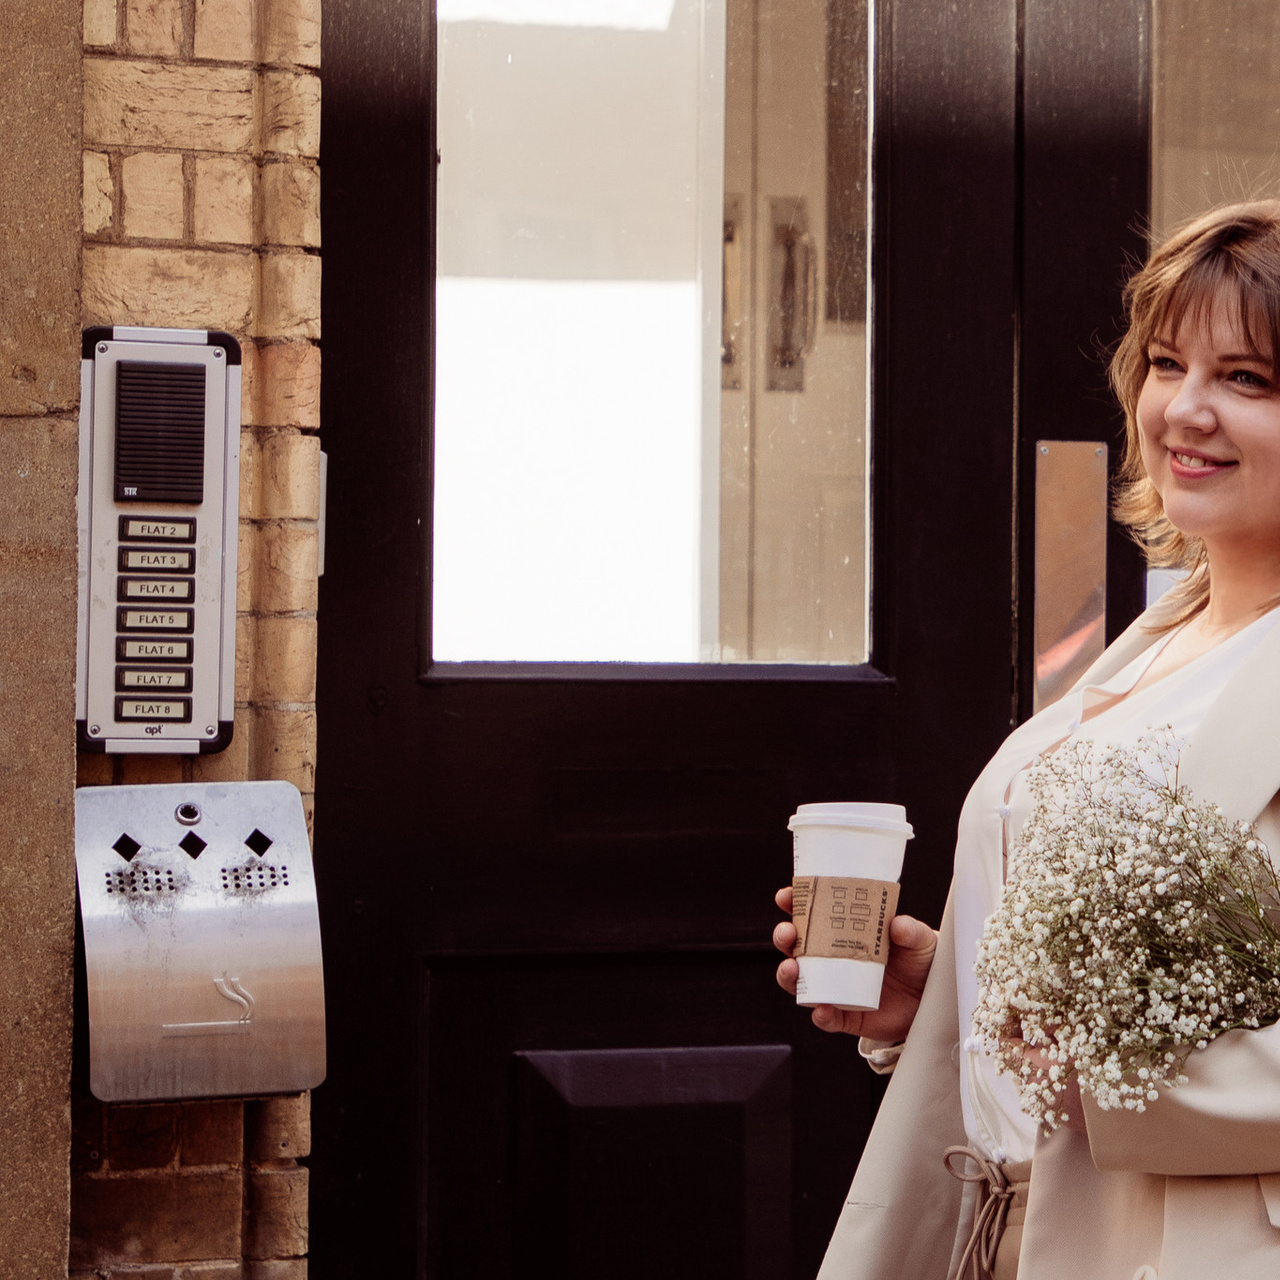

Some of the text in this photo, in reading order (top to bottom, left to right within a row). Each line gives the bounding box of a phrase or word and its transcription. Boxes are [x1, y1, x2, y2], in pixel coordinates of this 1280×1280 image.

[141, 524, 176, 535] FLAT 2
[140, 555, 176, 565] FLAT 3
[139, 584, 175, 594] FLAT 4
[139, 615, 174, 624] FLAT 5
[138, 645, 174, 655] FLAT 6
[137, 675, 172, 684] FLAT 7
[135, 704, 171, 714] FLAT 8
[874, 890, 888, 956] STARBUCKS
